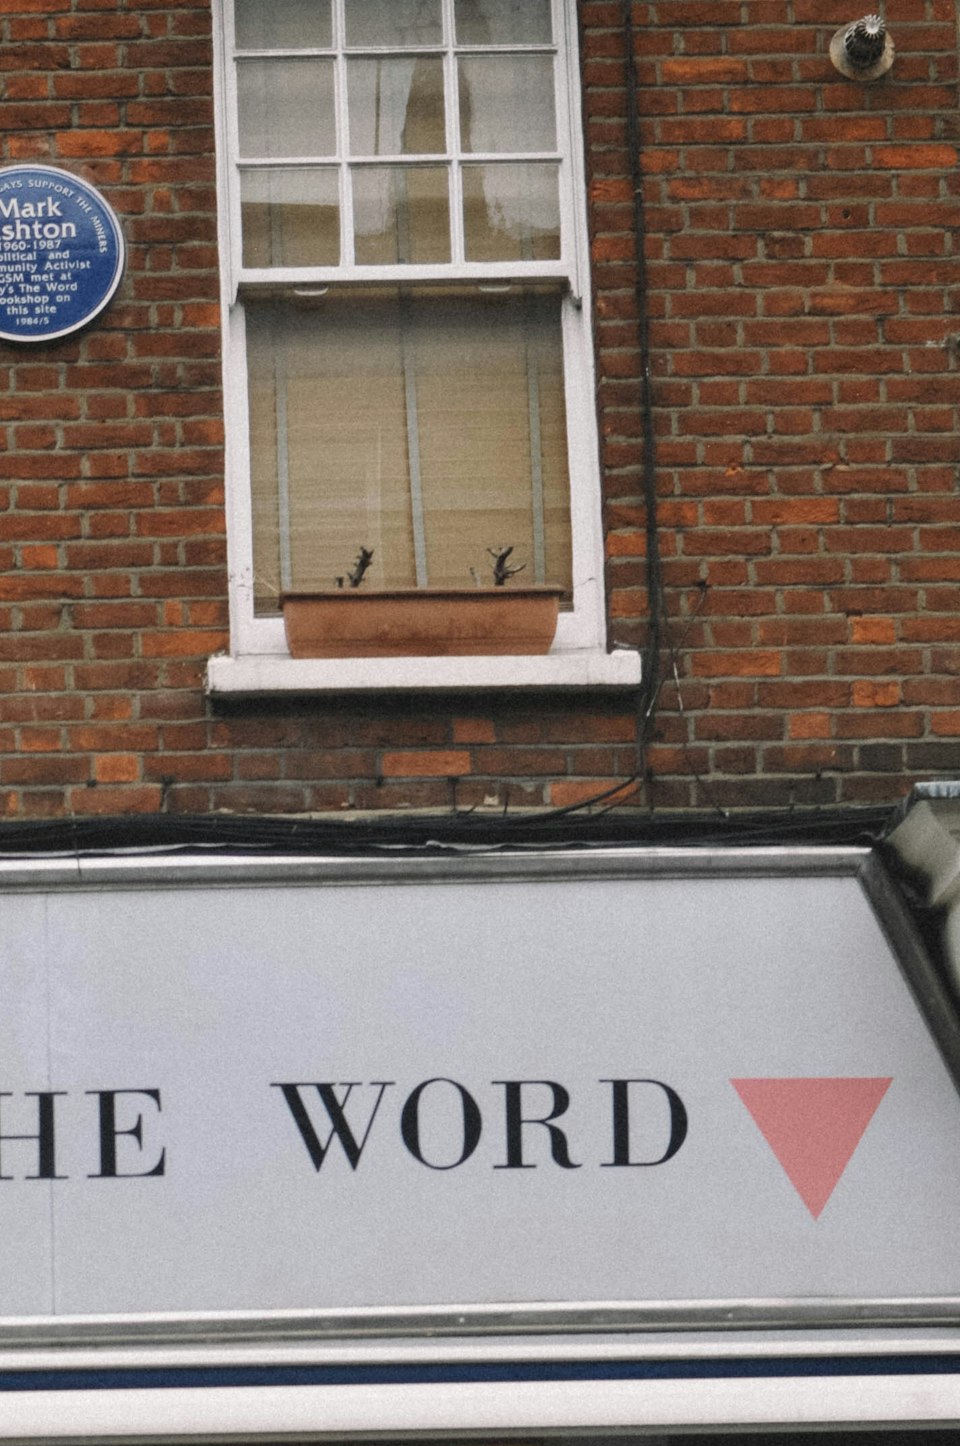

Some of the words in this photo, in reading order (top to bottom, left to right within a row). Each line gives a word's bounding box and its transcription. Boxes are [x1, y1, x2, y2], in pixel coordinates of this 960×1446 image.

[28, 179, 75, 198] SUPPORT
[75, 196, 93, 214] THE
[90, 215, 108, 254] MINERS
[48, 250, 70, 260] and
[44, 260, 91, 271] Activist
[30, 272, 54, 282] met
[60, 271, 72, 281] at
[19, 284, 41, 294] The
[46, 282, 78, 292] Word
[56, 294, 71, 303] on
[7, 305, 29, 315] this
[35, 304, 57, 314] site
[269, 1077, 690, 1173] WORD
